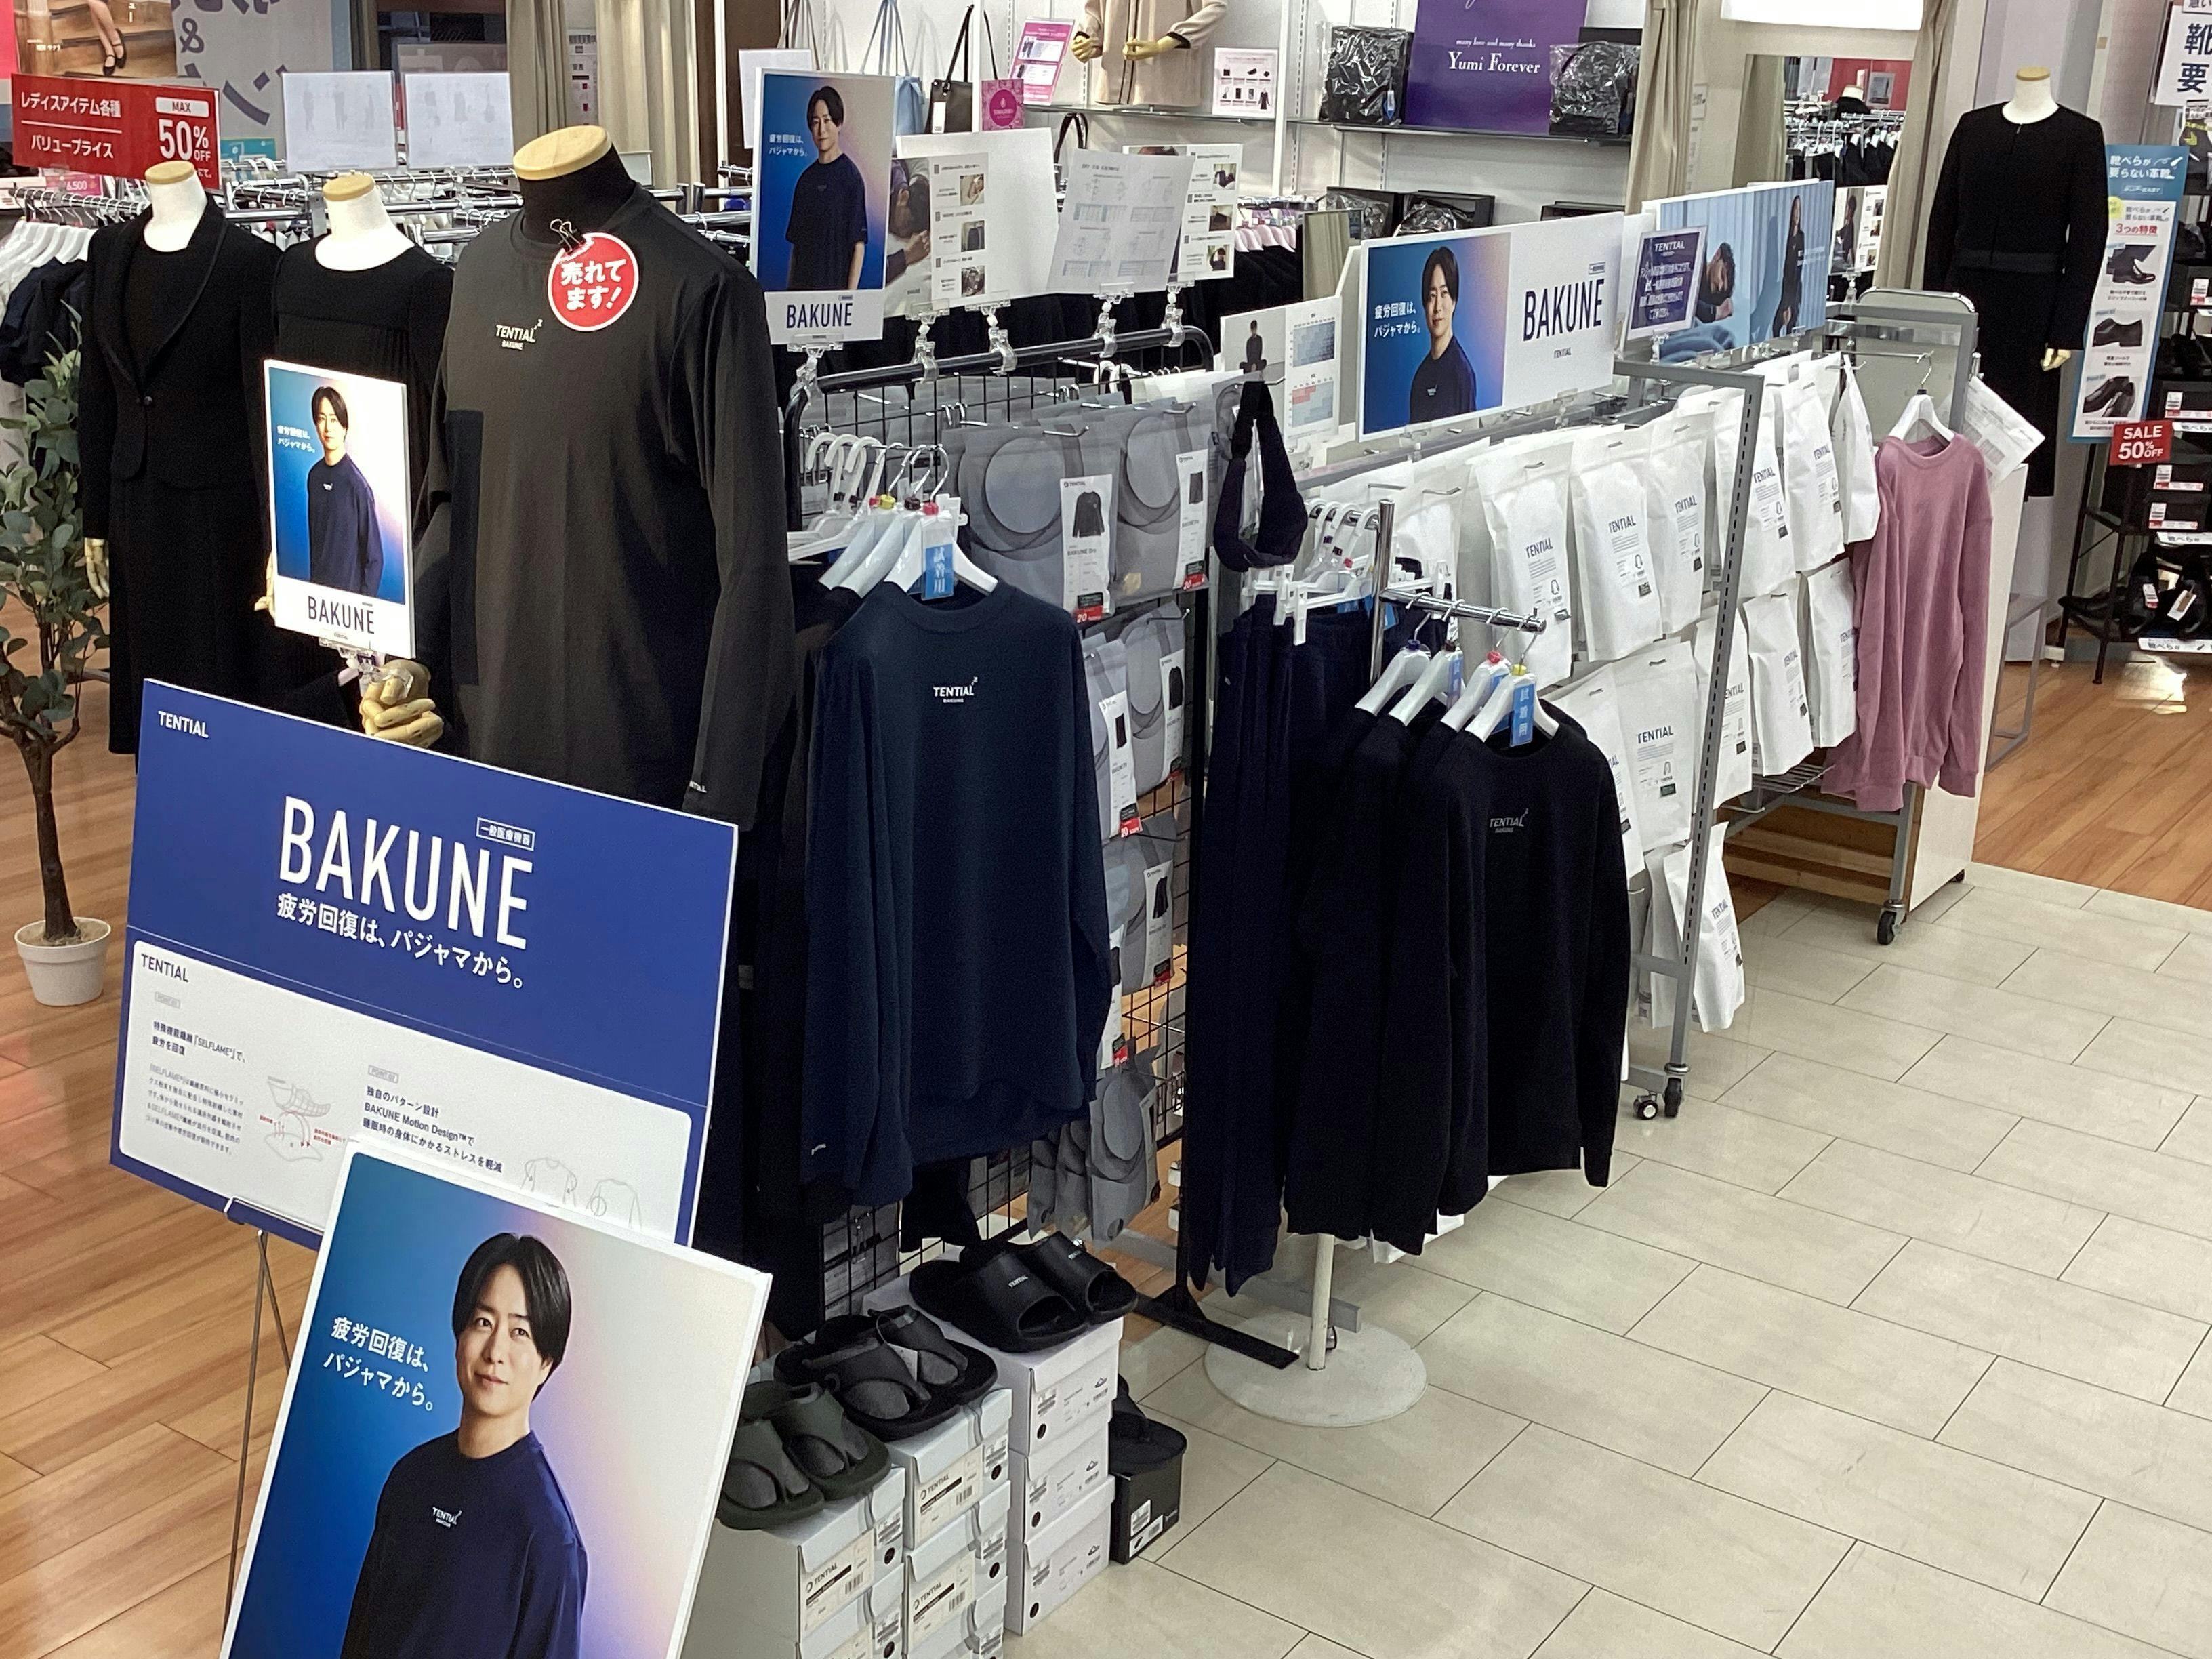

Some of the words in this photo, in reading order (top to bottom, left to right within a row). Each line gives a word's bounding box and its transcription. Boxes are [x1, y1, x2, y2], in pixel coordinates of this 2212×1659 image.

[1448, 51, 1484, 70] Yumi
[1487, 52, 1541, 73] Forever
[172, 103, 192, 114] MAX
[31, 134, 115, 159] バリュープライス
[159, 119, 209, 161] 50%
[194, 150, 211, 162] OFF
[1654, 241, 1685, 252] TENTIAL
[560, 259, 626, 285] 売れて
[787, 302, 853, 329] BAKUNE
[1523, 279, 1605, 342] BAKUNE
[2123, 425, 2163, 441] SALE
[2118, 441, 2155, 460] 50%
[2144, 448, 2164, 457] OFF
[308, 596, 375, 634] BAKUNE
[933, 684, 975, 697] TENTIAL
[1725, 683, 1744, 699] ENTIAL
[157, 710, 209, 739] TENTIAL
[1637, 726, 1674, 744] TENTIAL
[1490, 816, 1524, 827] TENTIAL
[279, 796, 533, 950] BAKUNE
[141, 954, 189, 983] TENTIAL
[365, 1102, 401, 1122] BAKUNE
[402, 1115, 429, 1132] Motion
[331, 1316, 429, 1372] 疲労回復は、
[323, 1352, 434, 1412] パジャマから。
[927, 1474, 949, 1496] TENTIAL
[814, 1563, 838, 1585] TENTIAL
[920, 1581, 942, 1603] TENTIAL
